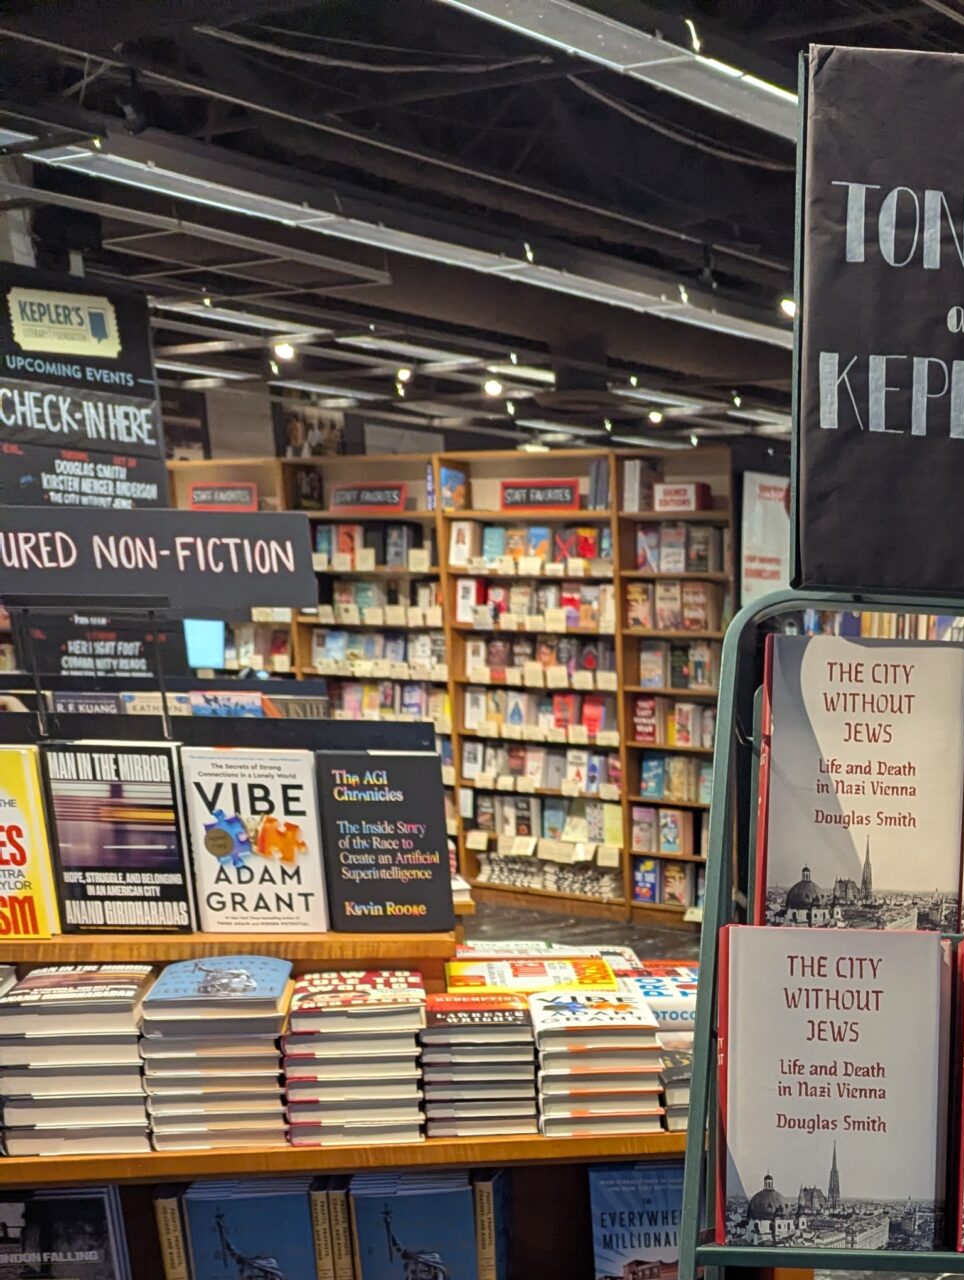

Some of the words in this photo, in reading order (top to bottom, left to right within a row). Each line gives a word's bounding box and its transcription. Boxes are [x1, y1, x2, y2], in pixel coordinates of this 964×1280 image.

[19, 300, 84, 326] KEPLER'S
[6, 355, 82, 379] UPCOMING
[86, 367, 134, 386] EVENTS
[0, 388, 106, 440] CHECK-IN
[108, 404, 156, 445] HERE
[92, 534, 295, 574] NON-FICTION
[826, 661, 866, 683] THE
[870, 663, 915, 686] CITY
[822, 692, 916, 715] WITHOUT
[842, 723, 893, 744] JEWS
[92, 753, 118, 781] THE
[117, 754, 171, 782] MIRROR
[331, 769, 360, 785] The
[363, 770, 388, 785] AGI
[818, 759, 842, 776] Life
[845, 761, 872, 776] and
[876, 761, 916, 778] Death
[333, 787, 404, 801] Chronicles
[816, 779, 830, 794] in
[834, 779, 866, 796] Nazi
[870, 780, 917, 798] Vienna
[192, 782, 306, 817] VIBE
[336, 820, 360, 834] The
[361, 820, 394, 834] Inside
[397, 821, 426, 838] Story
[814, 810, 870, 829] Douglas
[876, 811, 917, 829] Smith
[338, 835, 350, 848] of
[352, 837, 369, 849] the
[372, 837, 399, 849] Race
[402, 838, 414, 849] to
[340, 852, 375, 864] Create
[378, 855, 392, 864] an
[396, 850, 440, 864] Artificial
[214, 865, 302, 885] ADAM
[342, 867, 432, 883] Superintelligence
[206, 891, 315, 912] GRANT
[344, 902, 383, 916] Kevin
[386, 902, 427, 915] Roose
